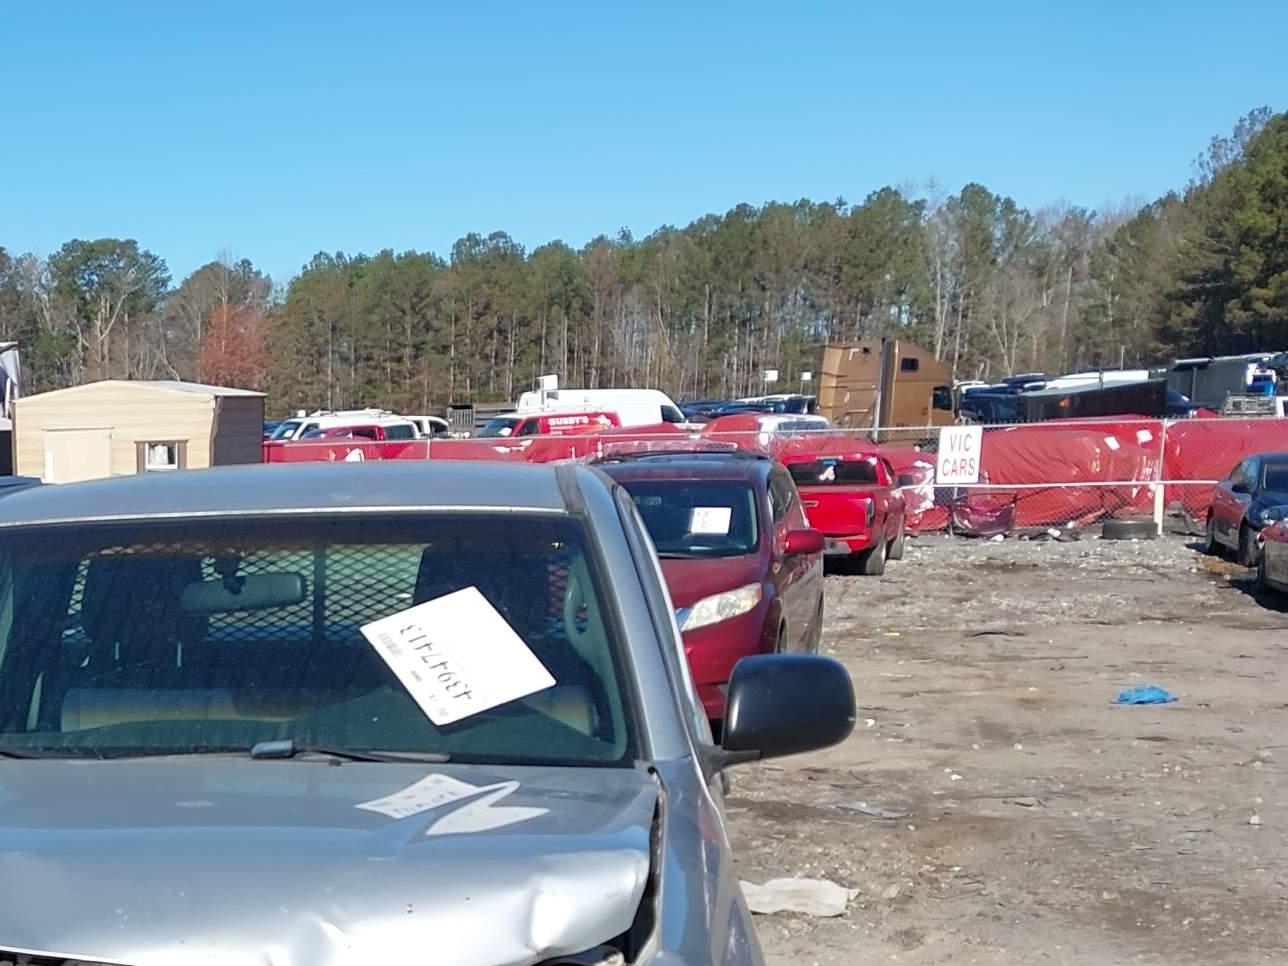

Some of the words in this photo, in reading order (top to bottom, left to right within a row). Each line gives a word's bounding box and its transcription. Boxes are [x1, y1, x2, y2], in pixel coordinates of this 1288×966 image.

[950, 434, 973, 452] VIC
[942, 458, 975, 476] CARS
[399, 624, 472, 700] 43947413
